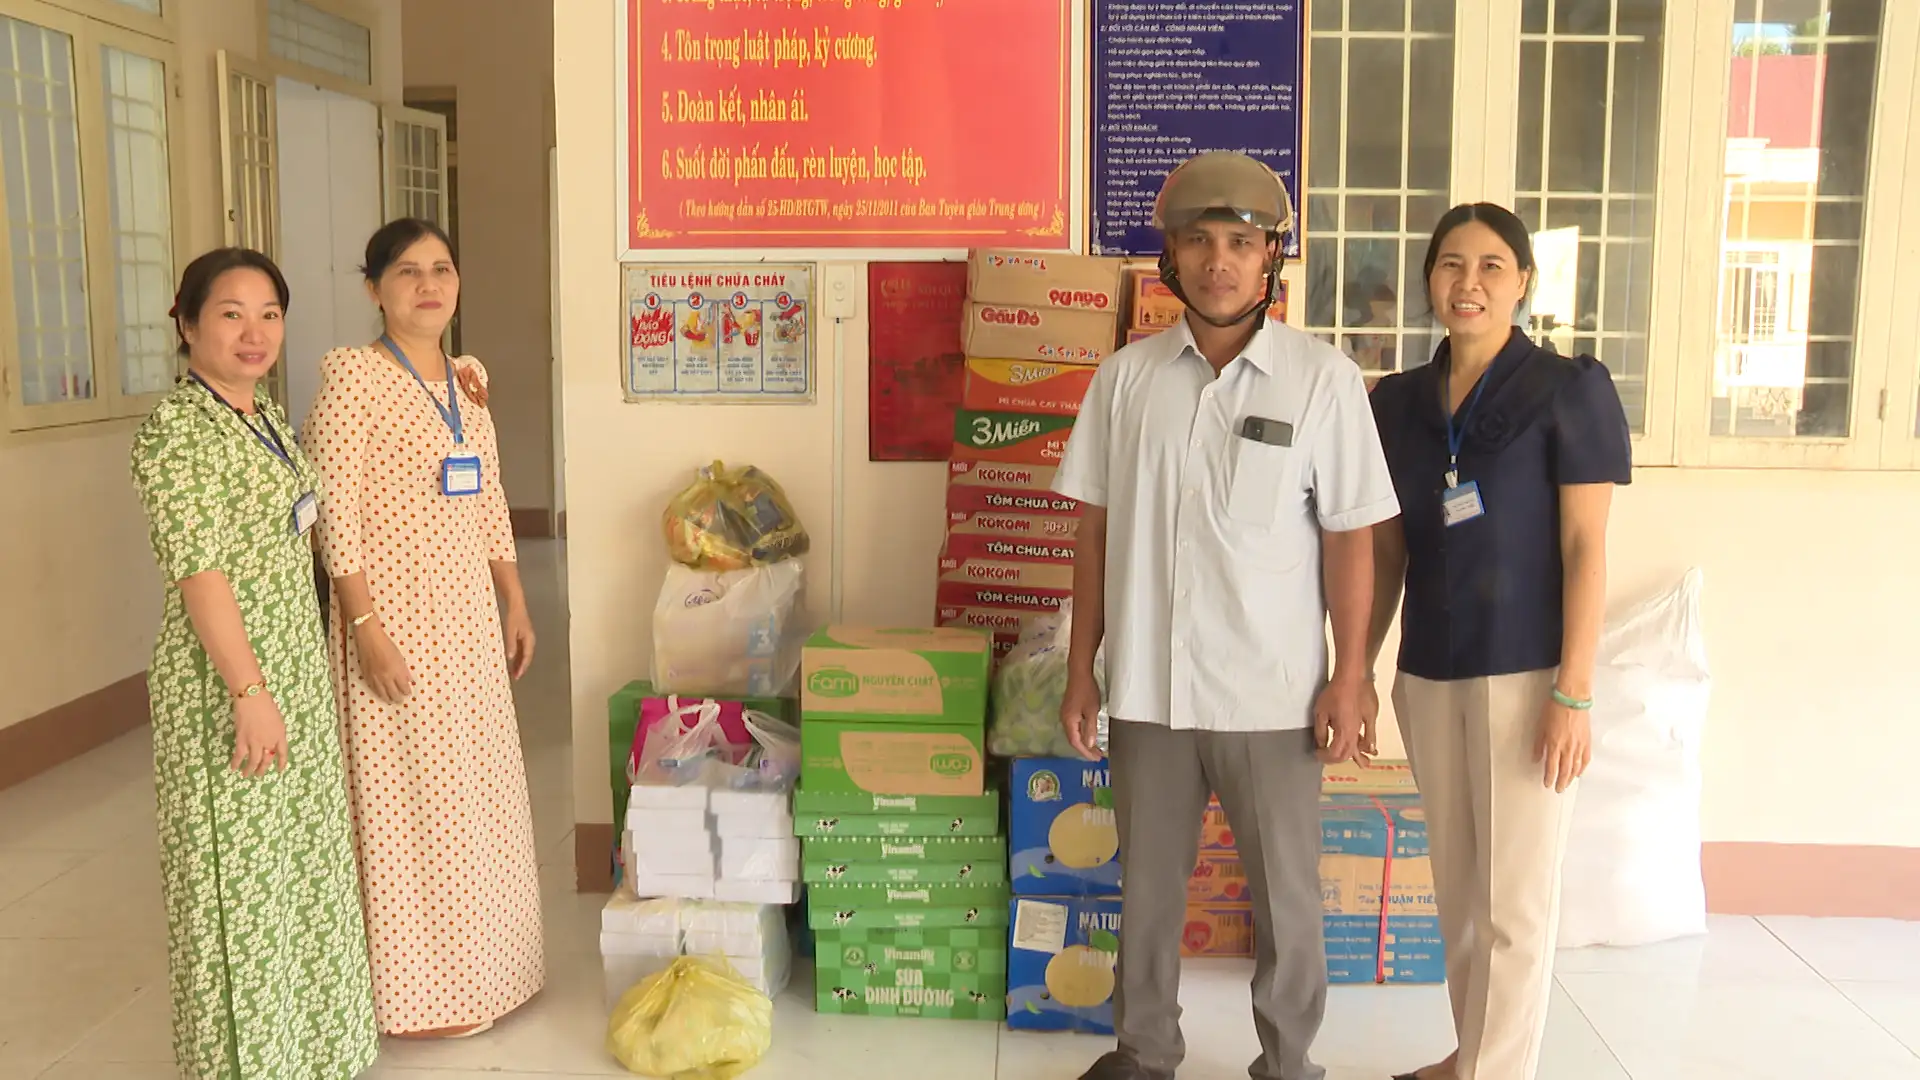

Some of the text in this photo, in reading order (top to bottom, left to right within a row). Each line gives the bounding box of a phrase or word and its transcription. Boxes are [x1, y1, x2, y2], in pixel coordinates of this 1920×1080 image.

[660, 26, 878, 70] 4. Tôn trọng luật pháp, kỷ cương.
[661, 84, 808, 128] 5. Đoàn kết, nhân ái.
[661, 142, 927, 186] 6. Suốt đời phấn đấu, rèn luyện, học tập.
[685, 200, 706, 217] Theo
[918, 198, 936, 217] Ban
[988, 198, 1016, 220] Trung
[680, 272, 712, 290] LỆNH
[716, 271, 750, 288] CHỮA
[754, 271, 786, 288] CHÁY
[648, 296, 655, 306] 1
[692, 296, 700, 306] 2
[734, 296, 744, 306] 3
[778, 295, 788, 306] 4
[980, 307, 1016, 325] Gấu
[978, 468, 1032, 484] KOKOMI
[986, 494, 1077, 511] TÔM CHUA CAY
[978, 516, 1030, 531] KOKOMI
[986, 542, 1014, 554] TÔM
[1016, 544, 1050, 558] CHUA
[968, 566, 1020, 580] KOKOMI
[976, 590, 1003, 603] TÔM
[1005, 592, 1039, 606] CHUA
[968, 614, 1020, 628] KOKOMI
[881, 842, 925, 859] Vinamilk
[884, 947, 935, 966] Vinamilk
[864, 986, 954, 1008] DINH DƯỠNG
